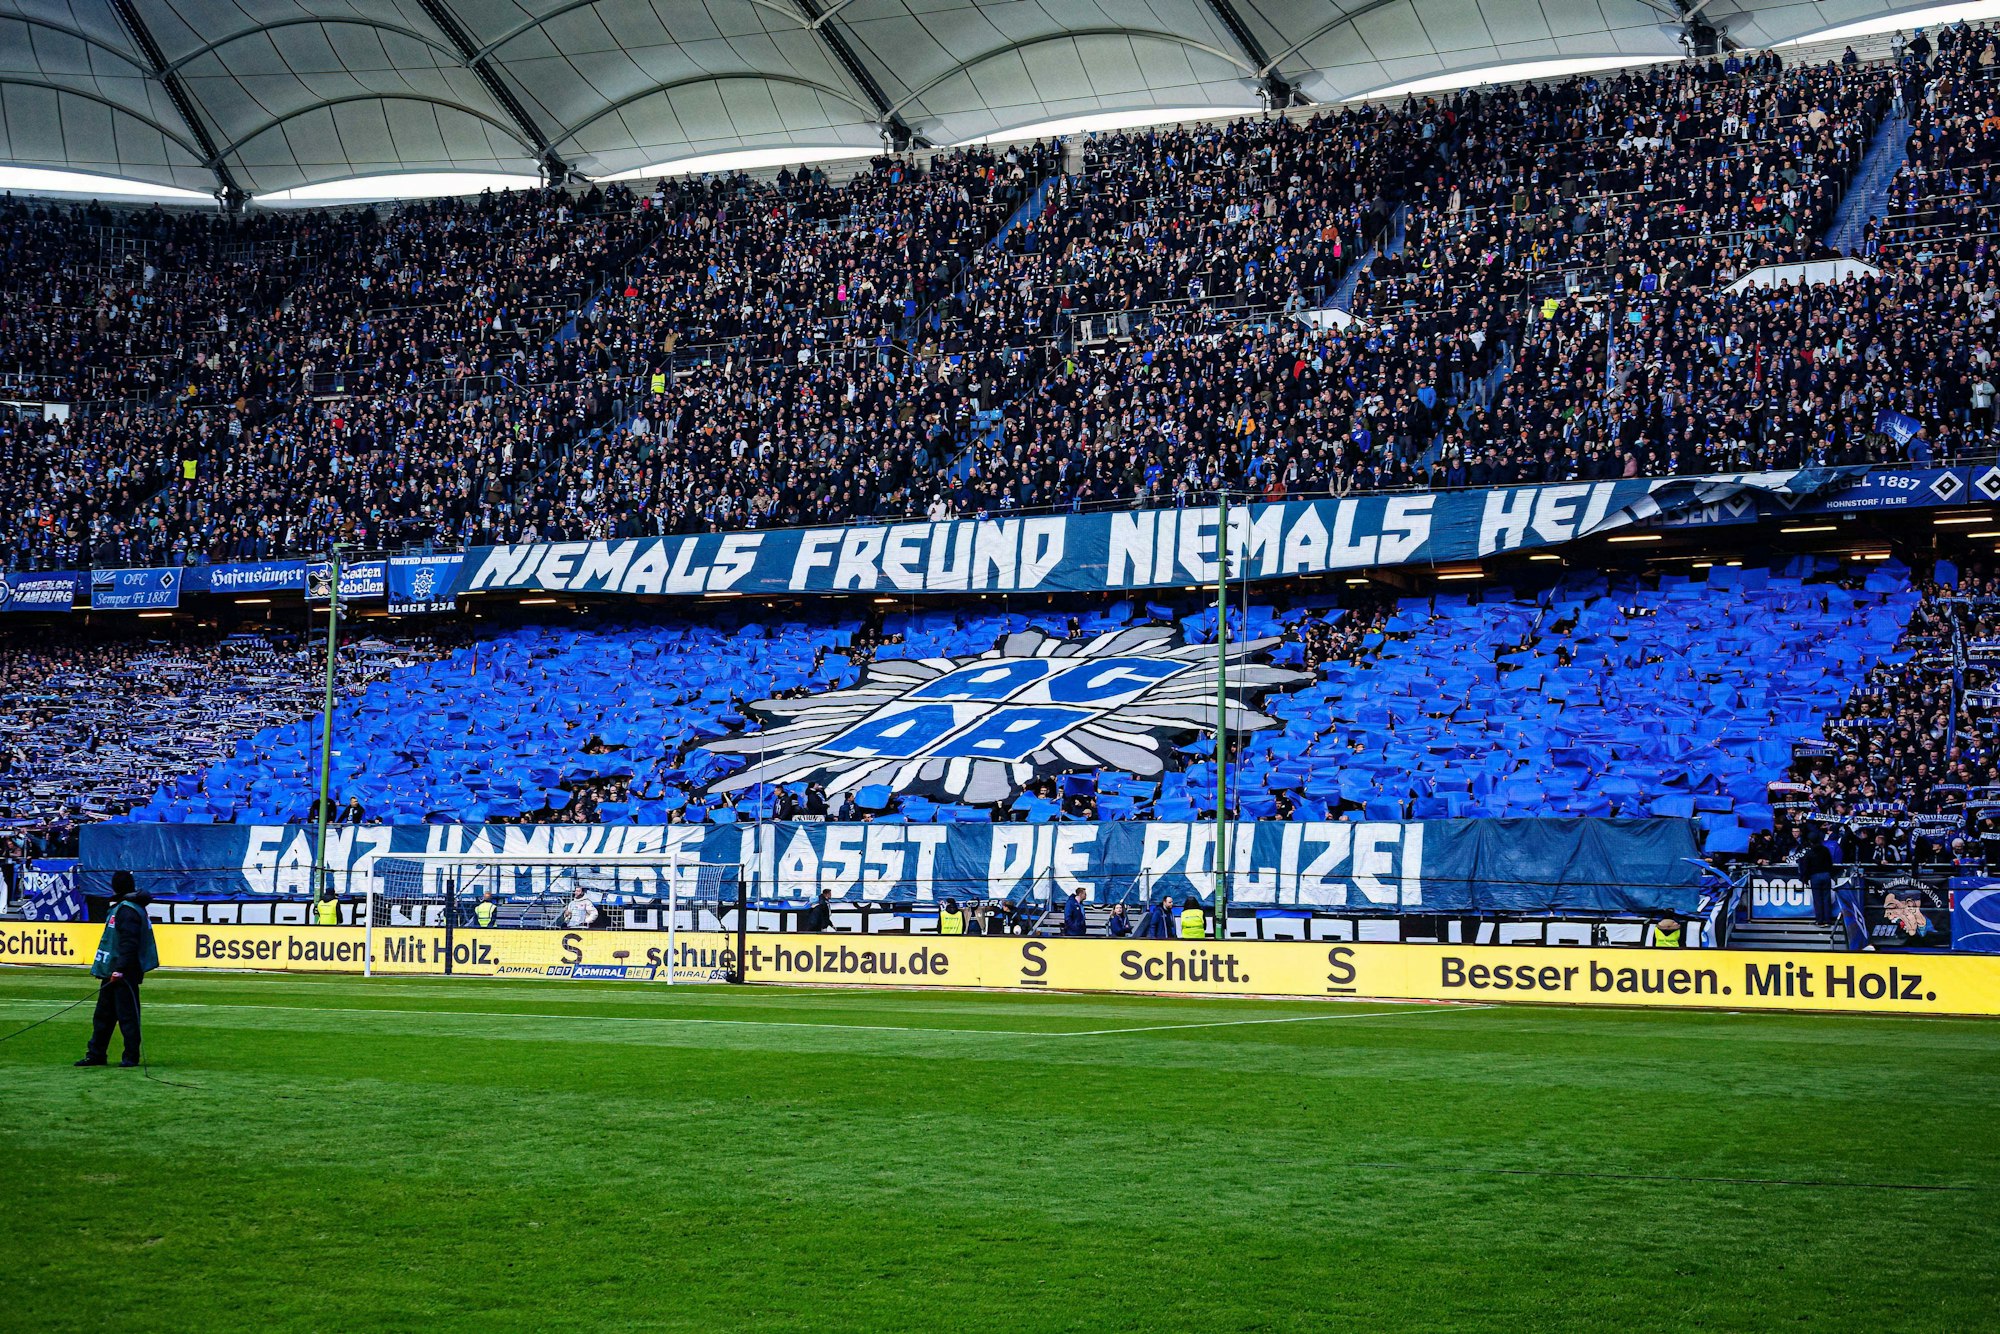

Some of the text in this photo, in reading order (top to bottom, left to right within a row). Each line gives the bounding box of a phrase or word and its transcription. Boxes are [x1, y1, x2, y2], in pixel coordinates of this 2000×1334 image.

[1878, 475, 1921, 491] 1887
[1826, 499, 1879, 508] HOHNSTORF
[469, 533, 764, 593] NIEMALS
[789, 518, 1066, 590] FREUND
[1106, 495, 1436, 586] NIEMALS
[421, 556, 450, 564] FAMILY
[123, 573, 149, 586] OFC
[13, 591, 73, 603] HAMBURG
[96, 591, 171, 607] Semper Fi 1887
[388, 604, 426, 614] BLOCK
[242, 823, 1424, 905] GANZ HAMBURG HASST DIE POLIZEI
[195, 934, 500, 965] Besser bauen. Mit Holz.
[647, 942, 949, 976] schuet-holzbau.de
[1020, 942, 1048, 977] S
[1120, 949, 1250, 983] Schütt.
[1327, 947, 1356, 985] S
[496, 965, 573, 976] ADMIRAL BET
[573, 967, 654, 980] ADMIRAL BET
[657, 969, 707, 980] AMIRAL
[1441, 957, 1937, 1001] Besser bauen. Mit Holz.
